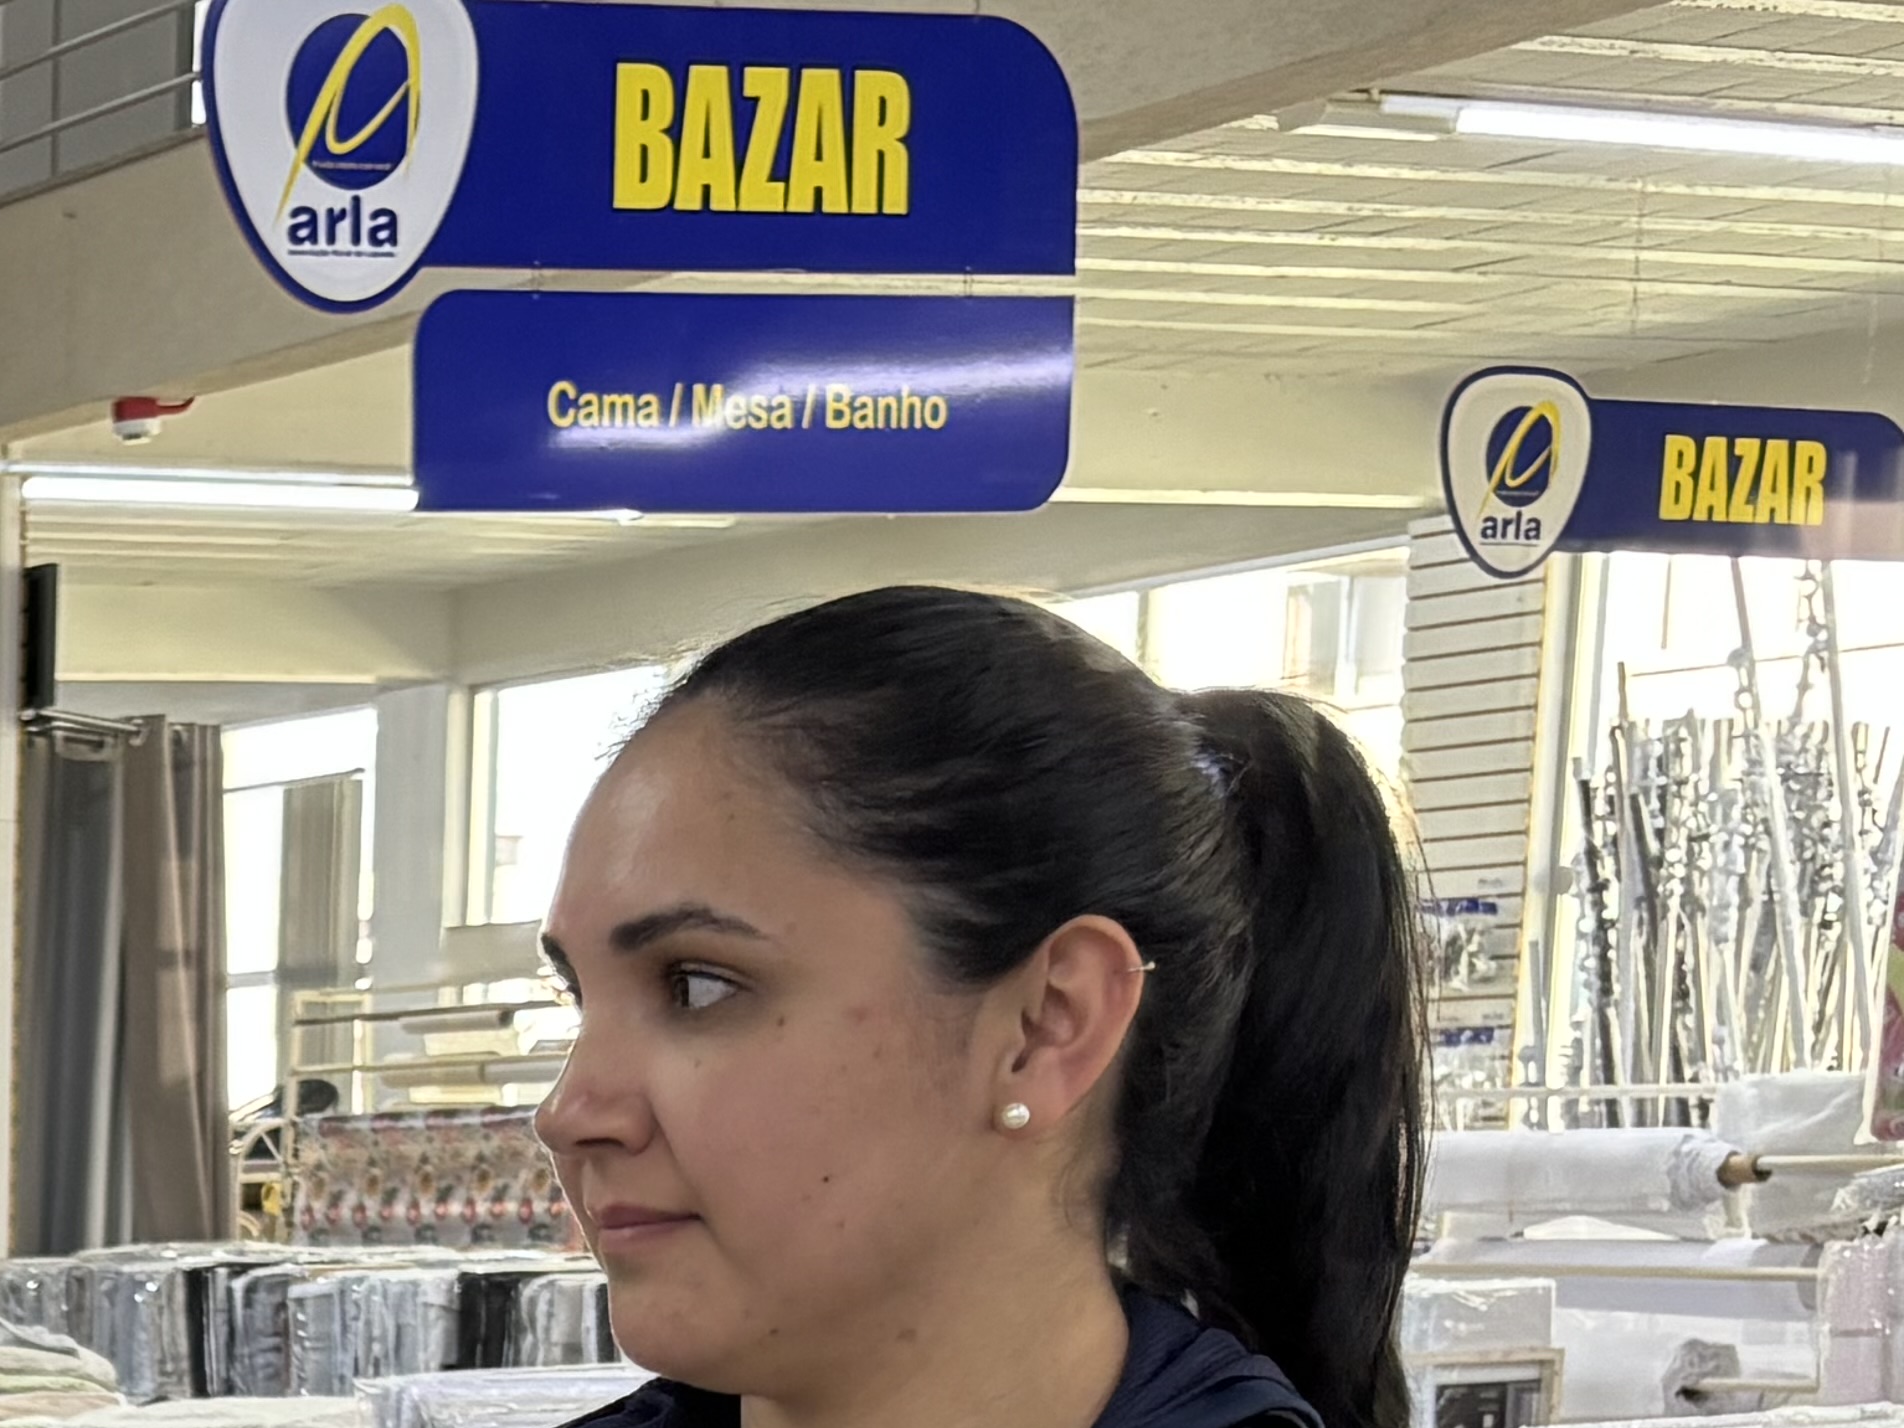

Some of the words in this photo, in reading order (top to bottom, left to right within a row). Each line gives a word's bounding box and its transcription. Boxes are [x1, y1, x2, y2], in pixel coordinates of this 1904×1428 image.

[612, 62, 910, 215] BAZAR
[287, 194, 398, 248] arla
[547, 380, 661, 429] Cama
[668, 381, 684, 428] /
[692, 382, 793, 430] Mesa
[801, 383, 817, 430] /
[824, 383, 948, 430] Banho
[1658, 433, 1827, 527] BAZAR
[1480, 510, 1542, 541] arla
